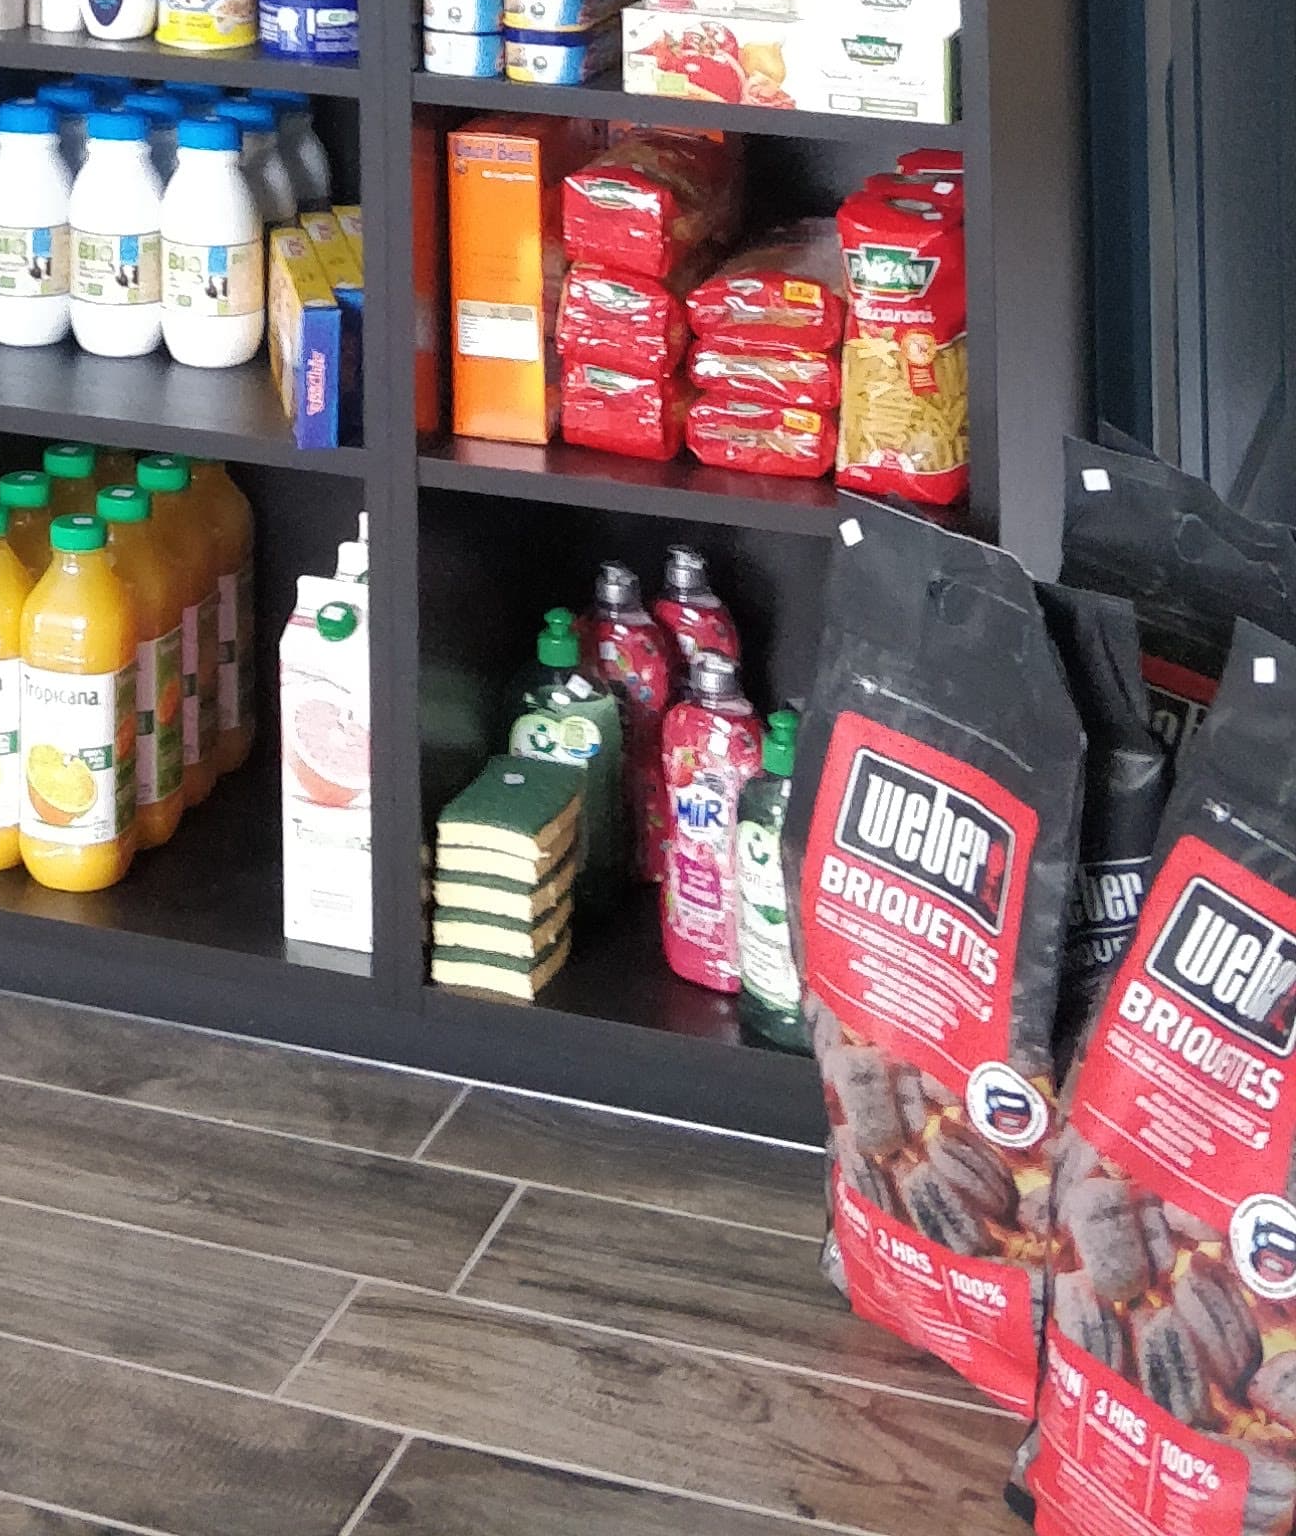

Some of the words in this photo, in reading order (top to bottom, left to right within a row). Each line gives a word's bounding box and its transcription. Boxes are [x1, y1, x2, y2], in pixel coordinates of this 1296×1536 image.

[857, 773, 988, 893] weber
[820, 853, 1001, 986] BRIQUETTES
[891, 1237, 934, 1274] HRS
[949, 1268, 1007, 1308] 100%
[1108, 1399, 1147, 1445] HRS
[1160, 1439, 1221, 1490] 100%
